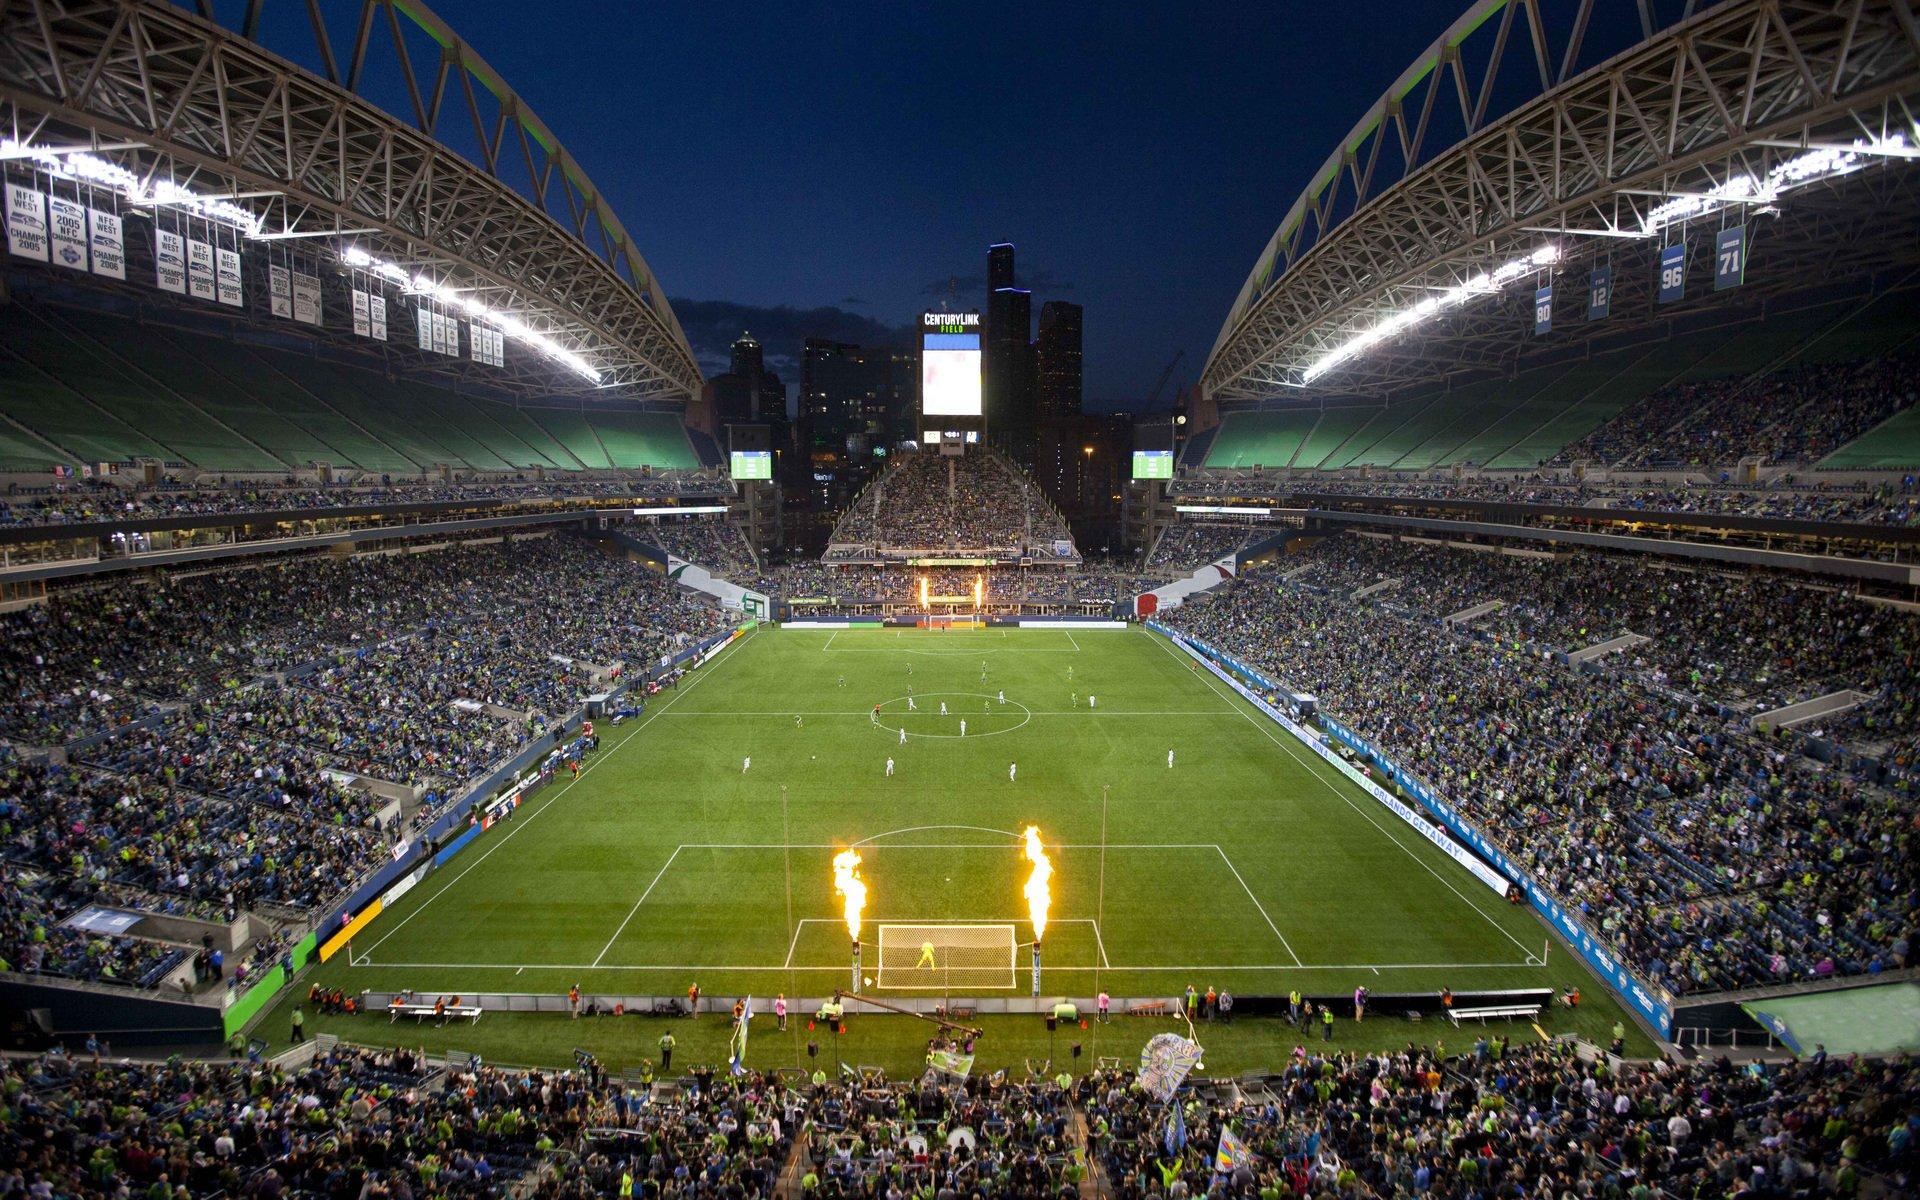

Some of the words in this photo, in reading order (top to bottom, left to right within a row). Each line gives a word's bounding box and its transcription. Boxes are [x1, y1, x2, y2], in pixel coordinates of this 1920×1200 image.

[16, 190, 34, 203] NFC
[15, 199, 38, 212] WEST
[57, 215, 80, 229] 2005
[98, 215, 114, 226] NFC
[60, 225, 77, 238] NFC
[97, 223, 117, 235] WEST
[10, 228, 46, 244] CHAMPS
[163, 234, 176, 244] NFC
[19, 239, 40, 252] 2005
[162, 242, 179, 252] WEST
[194, 244, 206, 253] NFC
[93, 250, 124, 264] CHAMPS
[192, 251, 209, 261] WEST
[222, 253, 234, 262] NFC
[1720, 250, 1739, 275] 71
[100, 259, 119, 271] 2006
[221, 260, 236, 270] WEST
[159, 267, 184, 279] CHAMPS
[1662, 266, 1683, 290] 96
[190, 274, 214, 287] CHAMPS
[219, 283, 242, 294] CHAMPS
[1592, 287, 1607, 307] 12
[1537, 304, 1550, 323] 80
[941, 325, 964, 333] FIELD
[1312, 740, 1324, 755] WIN
[1329, 754, 1363, 784] SOUNDERS
[1363, 780, 1374, 792] FC
[1374, 787, 1412, 820] ORLANDO
